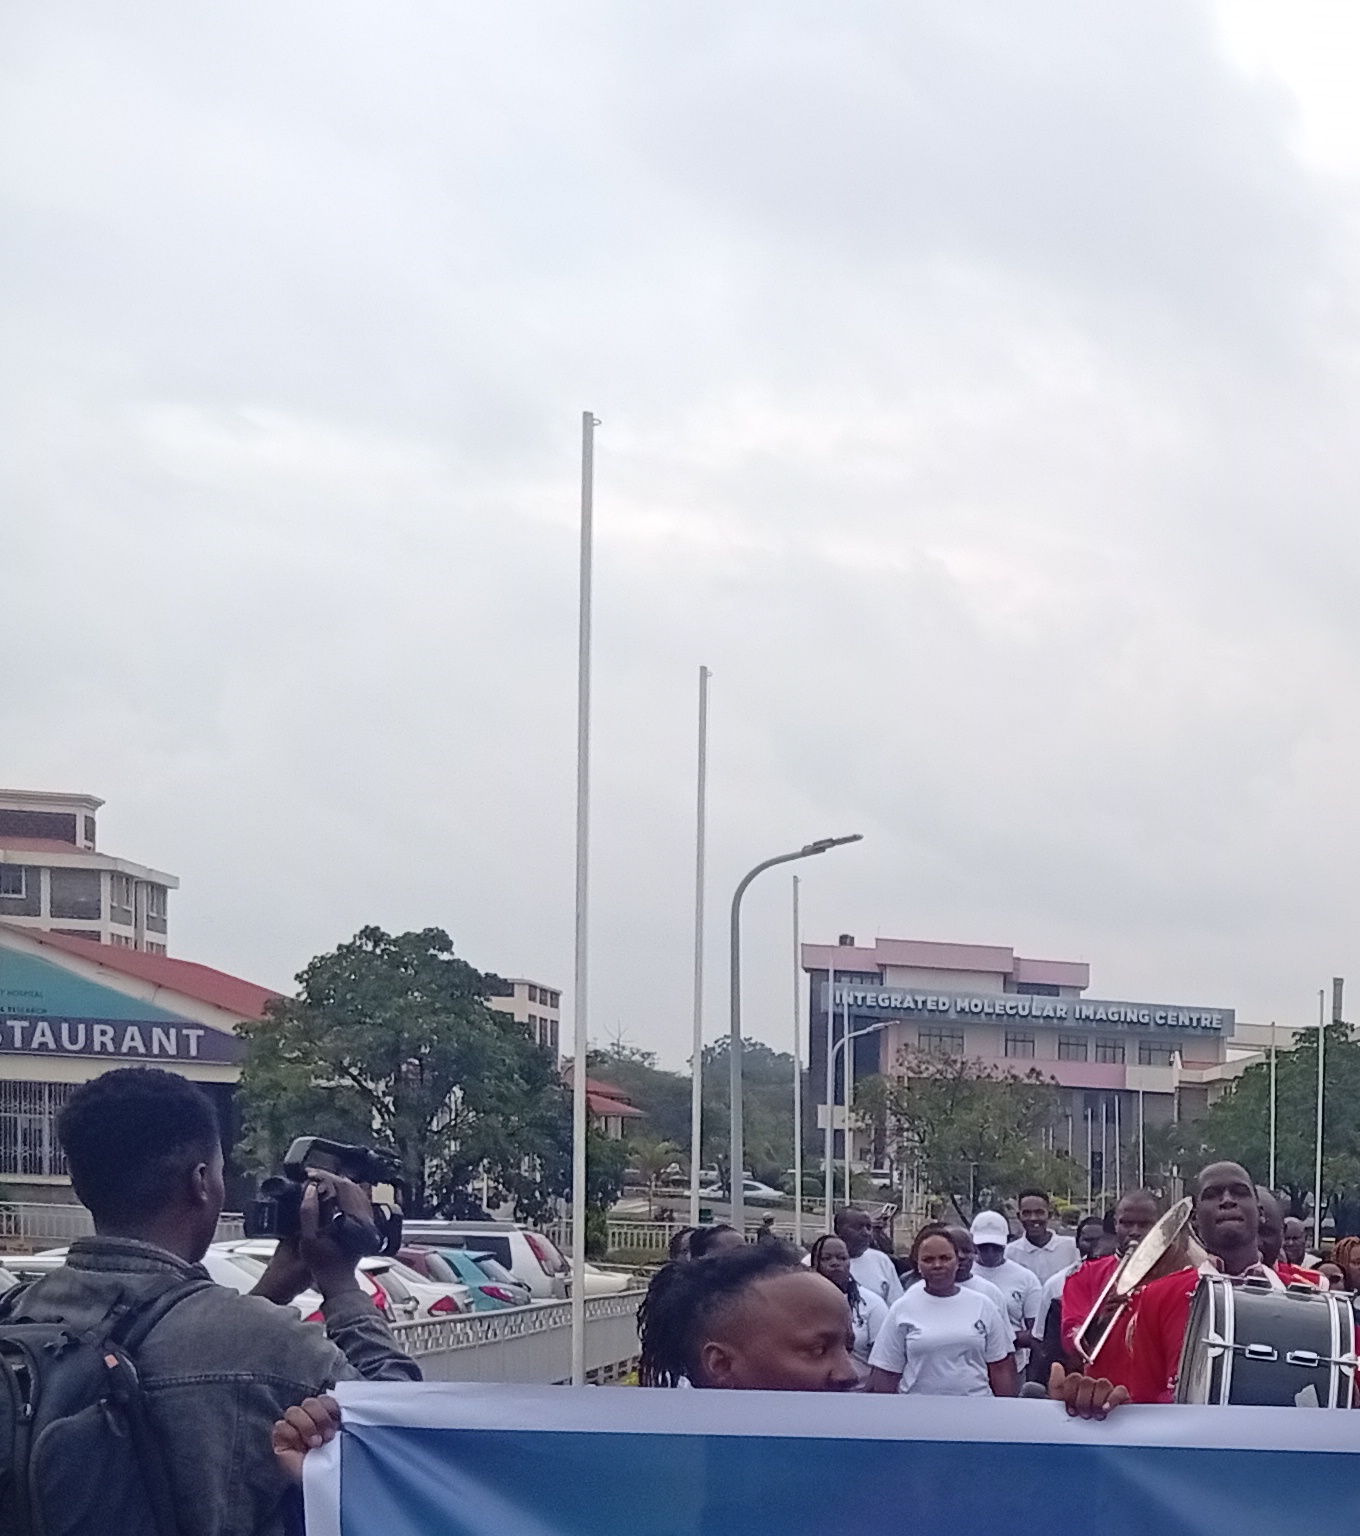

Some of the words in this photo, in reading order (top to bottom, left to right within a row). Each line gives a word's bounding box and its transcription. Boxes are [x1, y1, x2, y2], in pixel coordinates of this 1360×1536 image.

[835, 989, 950, 1011] INTEGRATED
[956, 998, 1067, 1019] MOLECULAR
[1074, 1005, 1150, 1024] IMAGING
[1155, 1010, 1222, 1029] CENTRE
[0, 1020, 205, 1057] TAURANT
